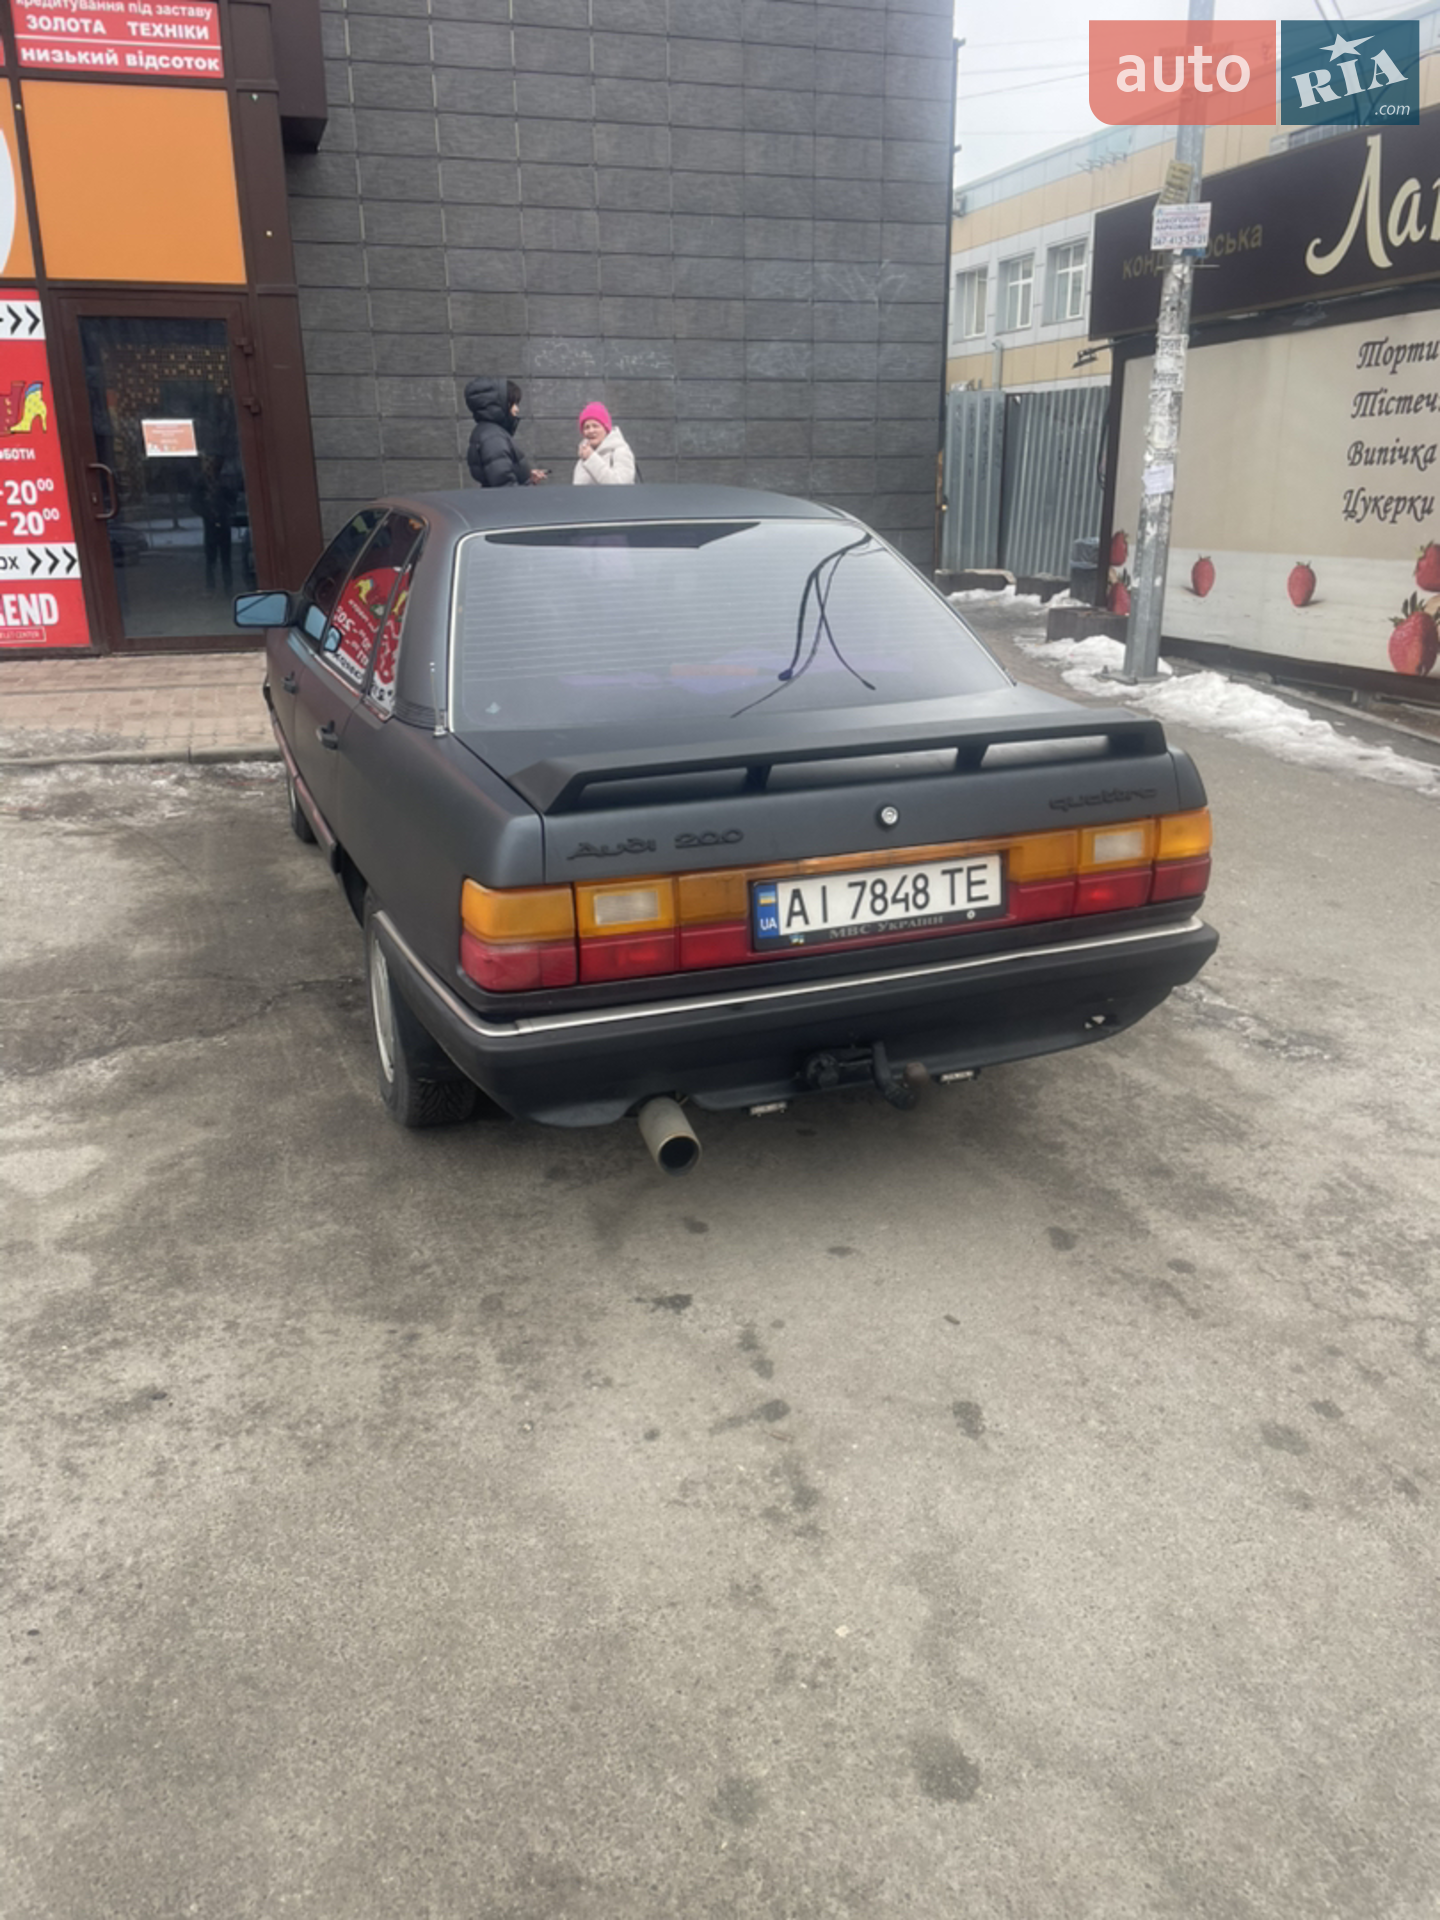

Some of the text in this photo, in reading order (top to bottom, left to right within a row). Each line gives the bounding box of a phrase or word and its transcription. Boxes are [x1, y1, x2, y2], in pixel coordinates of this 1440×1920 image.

[128, 1, 153, 16] під
[155, 7, 212, 20] заставу
[26, 15, 210, 40] ЗОЛОТА ТЕХНІКИ
[125, 50, 220, 71] відсоток
[1356, 336, 1440, 375] Торти
[1351, 387, 1440, 419] Тістеч
[1347, 437, 1437, 472] Випічка
[1342, 487, 1435, 524] Цукерки
[0, 593, 59, 626] END
[1048, 787, 1157, 813] quattro
[566, 828, 744, 861] Audi 200
[847, 872, 930, 920] 7848
[940, 864, 989, 906] TE
[760, 918, 777, 931] UA
[829, 924, 871, 940] МВС
